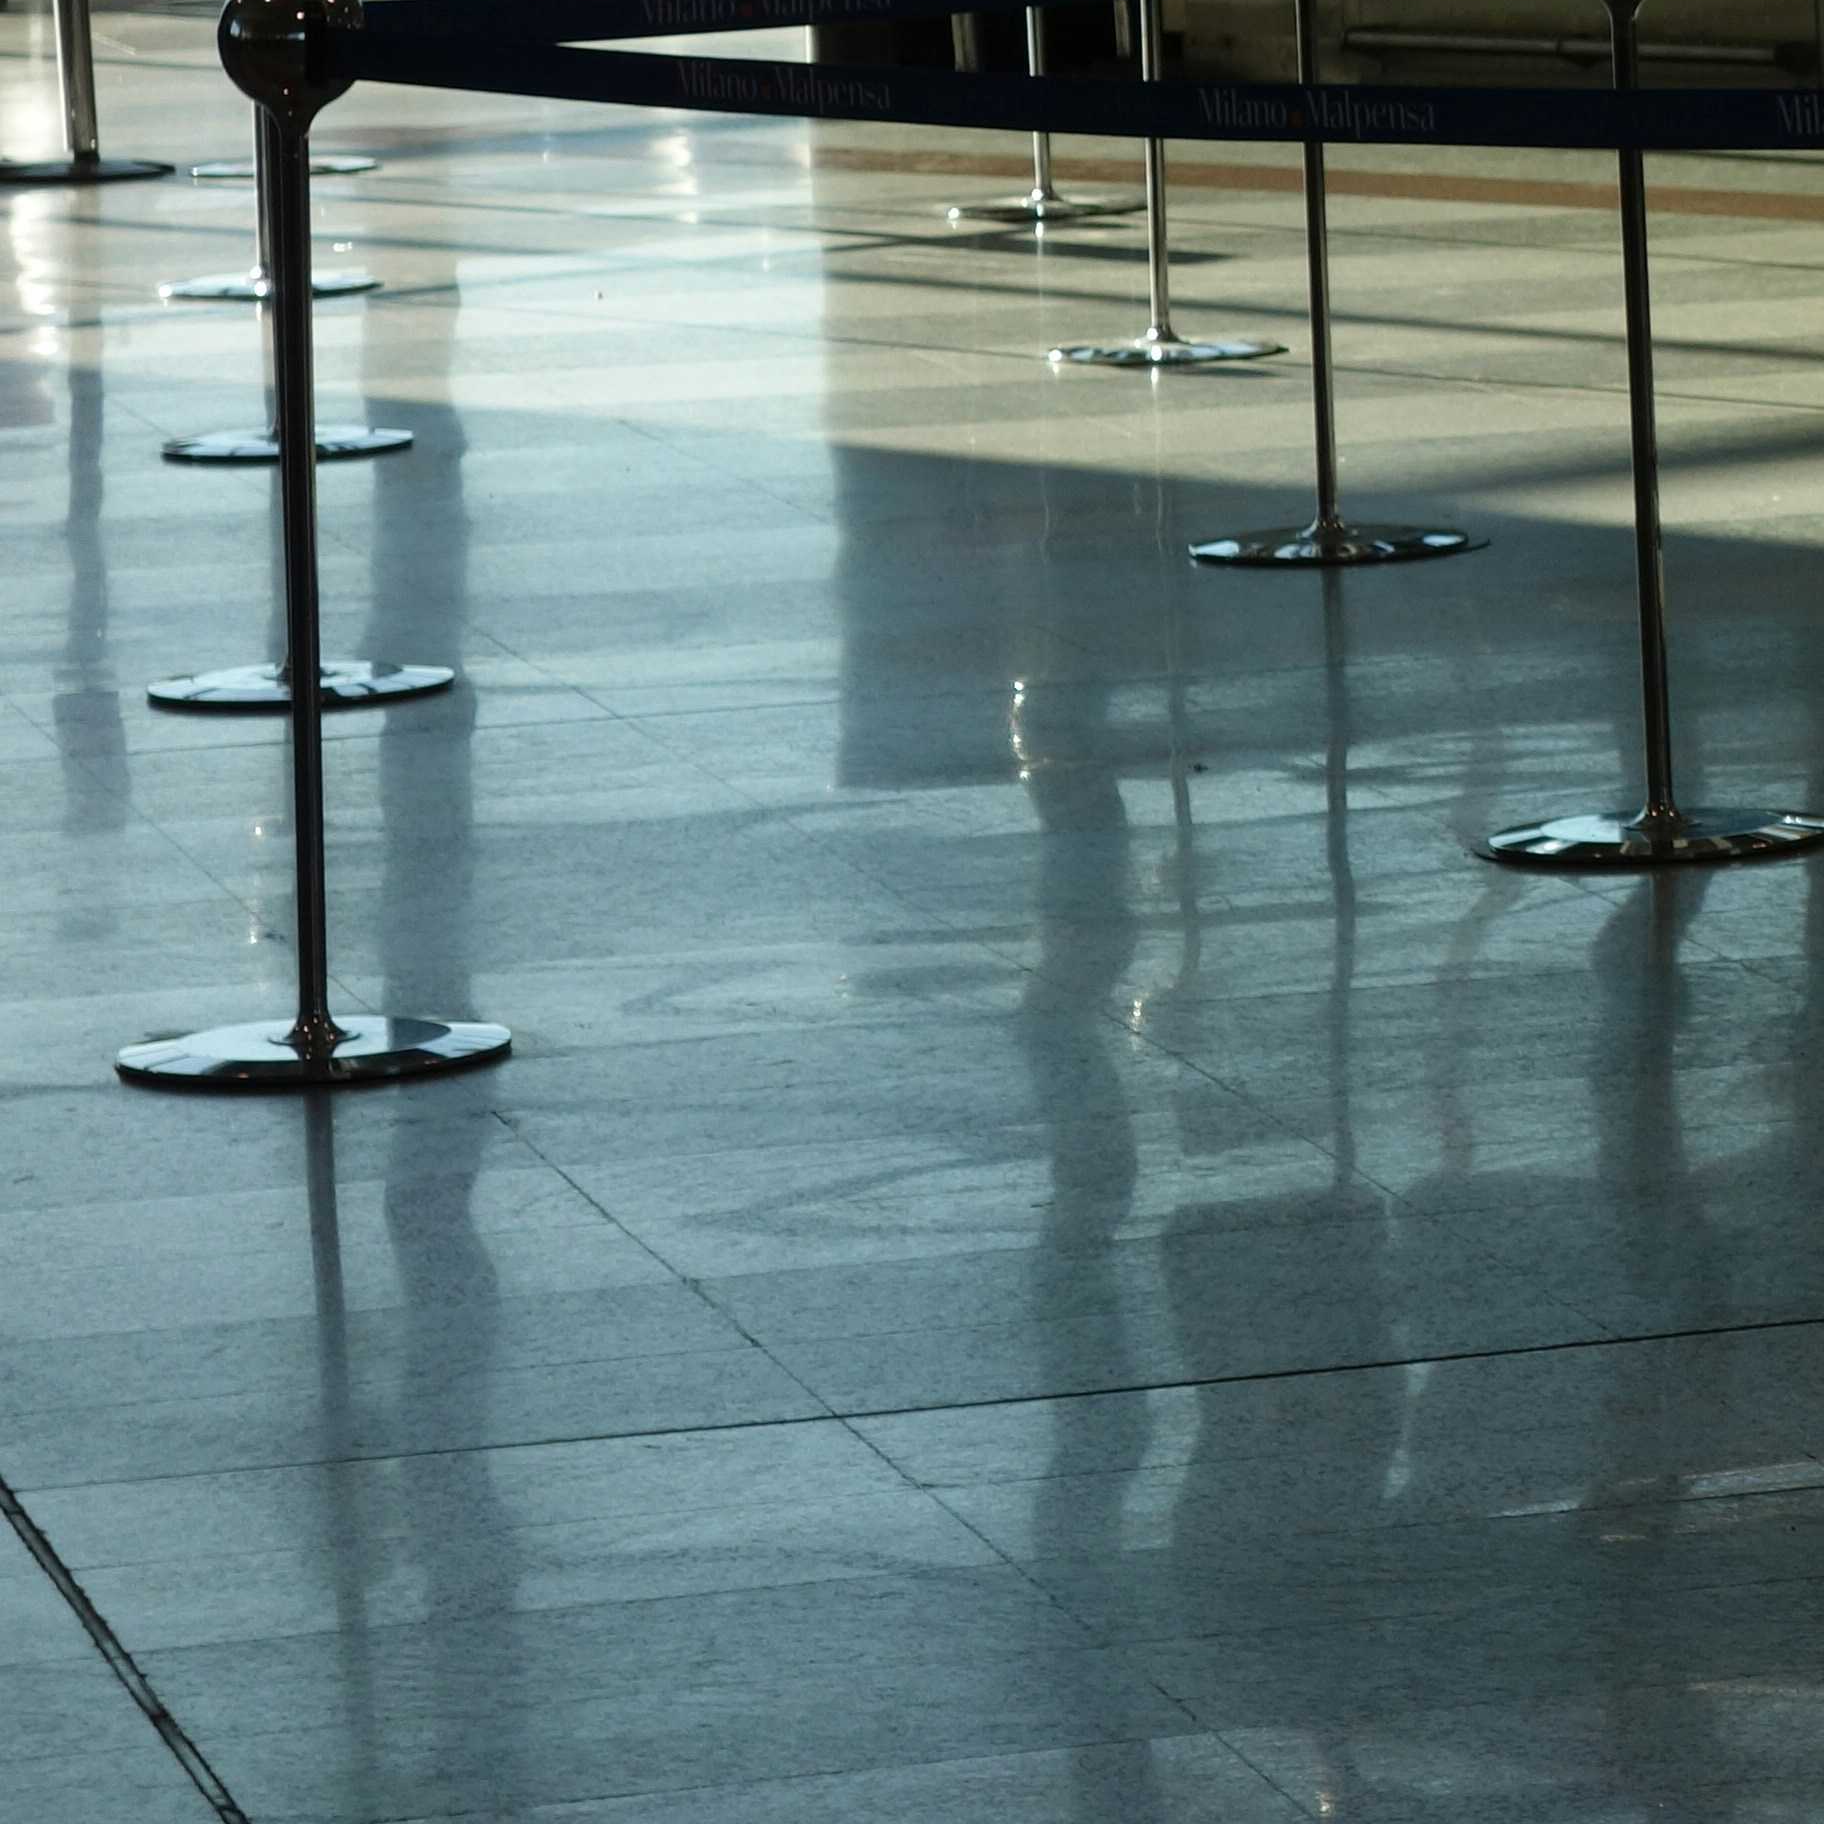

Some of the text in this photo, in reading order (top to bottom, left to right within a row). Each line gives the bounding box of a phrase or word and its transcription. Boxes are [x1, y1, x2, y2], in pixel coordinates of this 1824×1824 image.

[674, 60, 896, 116] Milano Malpensa
[1195, 87, 1440, 139] Milano Malpensa
